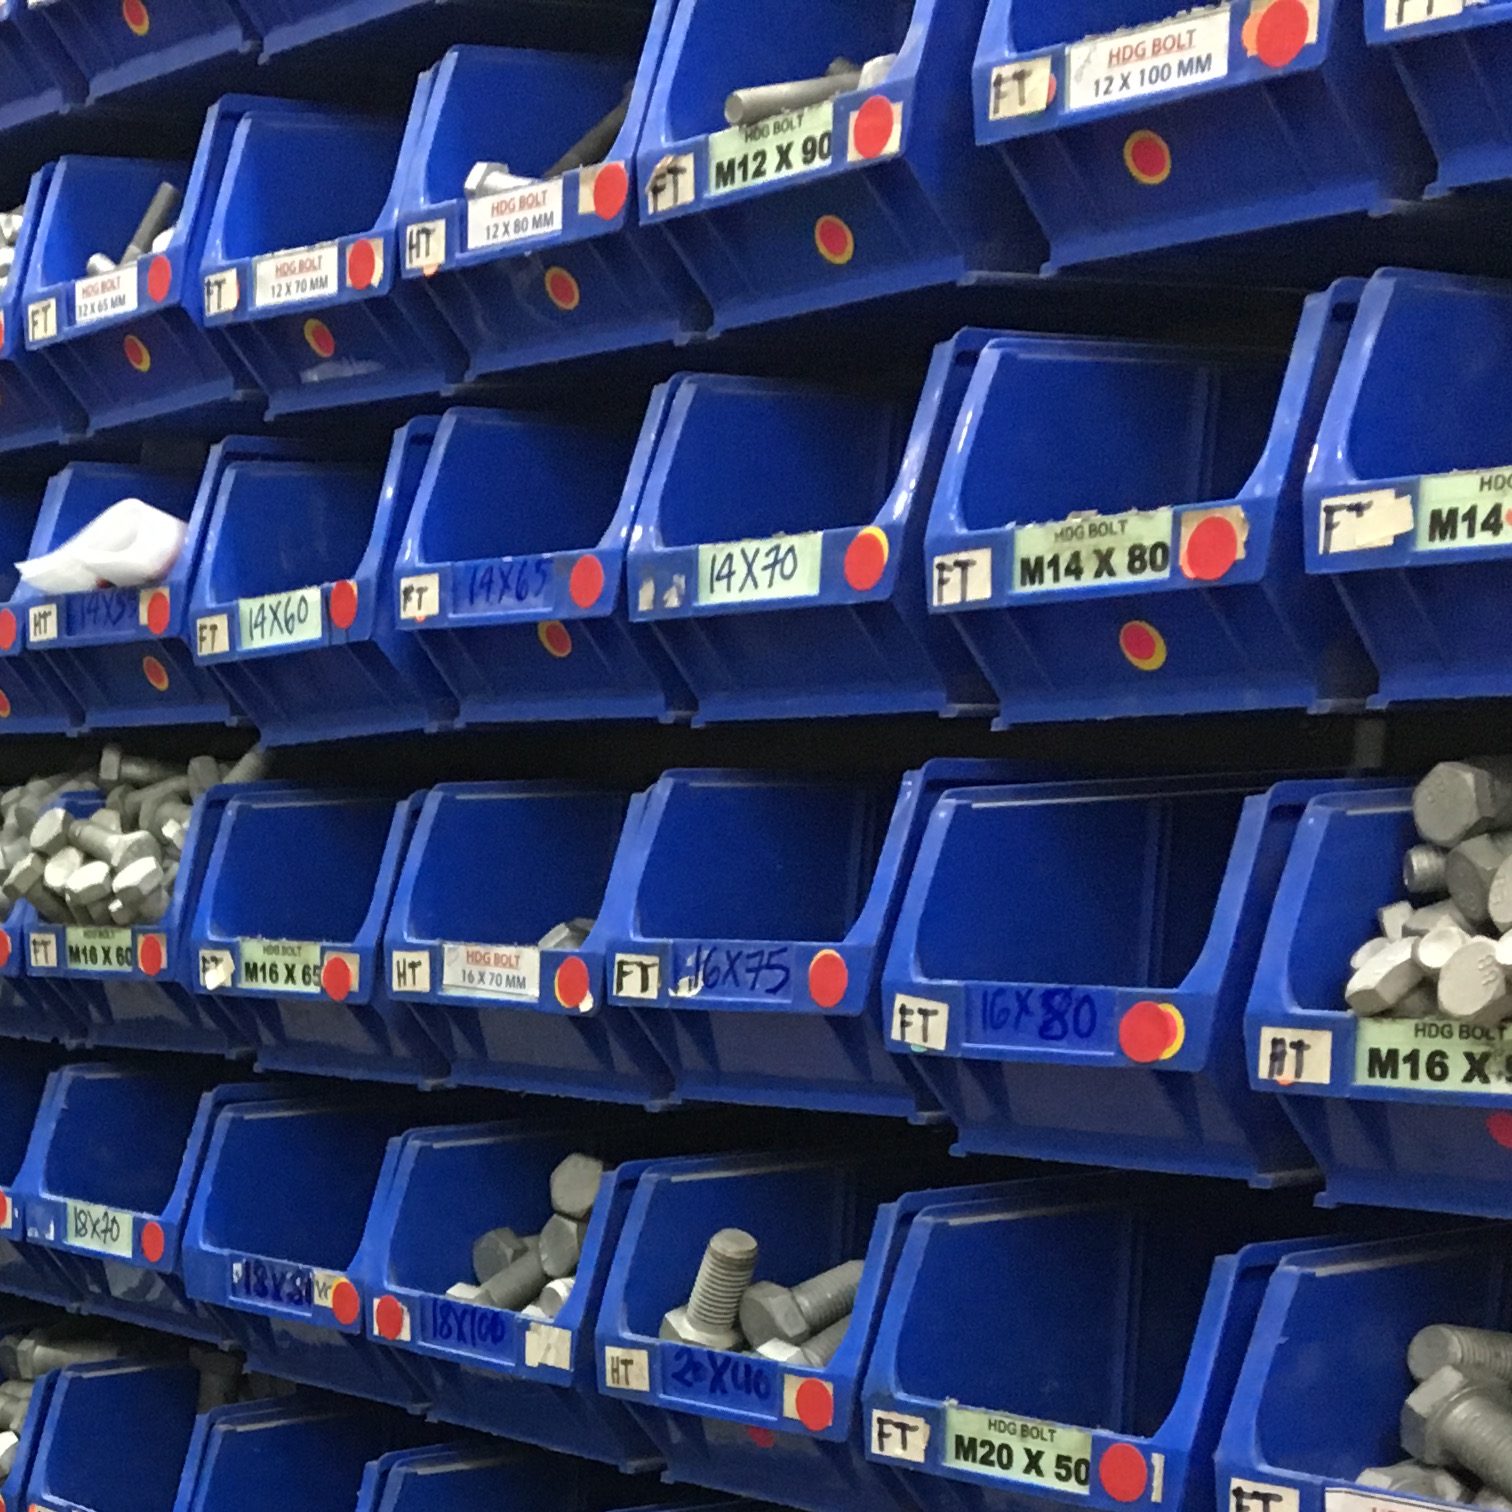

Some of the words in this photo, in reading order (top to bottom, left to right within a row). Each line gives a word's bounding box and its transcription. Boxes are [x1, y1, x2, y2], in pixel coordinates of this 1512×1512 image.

[1108, 43, 1147, 68] HDG
[1150, 29, 1197, 59] BOLT
[1093, 77, 1115, 98] 12
[1118, 74, 1131, 92] X
[1139, 63, 1171, 87] 100
[1177, 54, 1213, 78] MM
[745, 124, 770, 143] HDG
[773, 113, 804, 135] BOLT
[715, 152, 766, 189] M12
[775, 141, 793, 173] X
[802, 131, 832, 165] 90
[491, 198, 516, 217] HDG
[519, 190, 547, 212] BOLT
[486, 225, 499, 239] 12
[502, 223, 510, 237] X
[532, 212, 555, 230] MM
[297, 255, 323, 273] BOLT
[309, 275, 328, 291] MM
[1087, 518, 1129, 538] BOLT
[1428, 502, 1503, 543] M14
[1020, 552, 1083, 588] M14
[1093, 547, 1116, 579] X
[1128, 541, 1169, 575] 80
[936, 558, 975, 603] FT
[248, 595, 309, 642] 14X60
[102, 946, 113, 966] X
[466, 950, 490, 966] HDG
[492, 951, 522, 968] BOLT
[245, 961, 278, 984] M16
[283, 963, 297, 984] X
[302, 964, 321, 987] 65
[397, 960, 422, 987] HT
[462, 969, 475, 984] 16
[476, 970, 486, 986] X
[504, 972, 527, 989] MM
[617, 959, 659, 995] FT
[899, 1003, 939, 1043] FT
[1414, 1023, 1453, 1039] HDG
[1458, 1024, 1507, 1041] BOLT
[1368, 1047, 1450, 1082] M16
[1461, 1051, 1491, 1084] X
[74, 1205, 121, 1244] 18X70
[610, 1356, 634, 1386] HT
[876, 1416, 919, 1453] FT
[987, 1418, 1018, 1436] HDG
[1020, 1423, 1057, 1443] BOLT
[954, 1434, 1013, 1470] M20
[1022, 1447, 1045, 1478] X
[1054, 1455, 1090, 1486] 50
